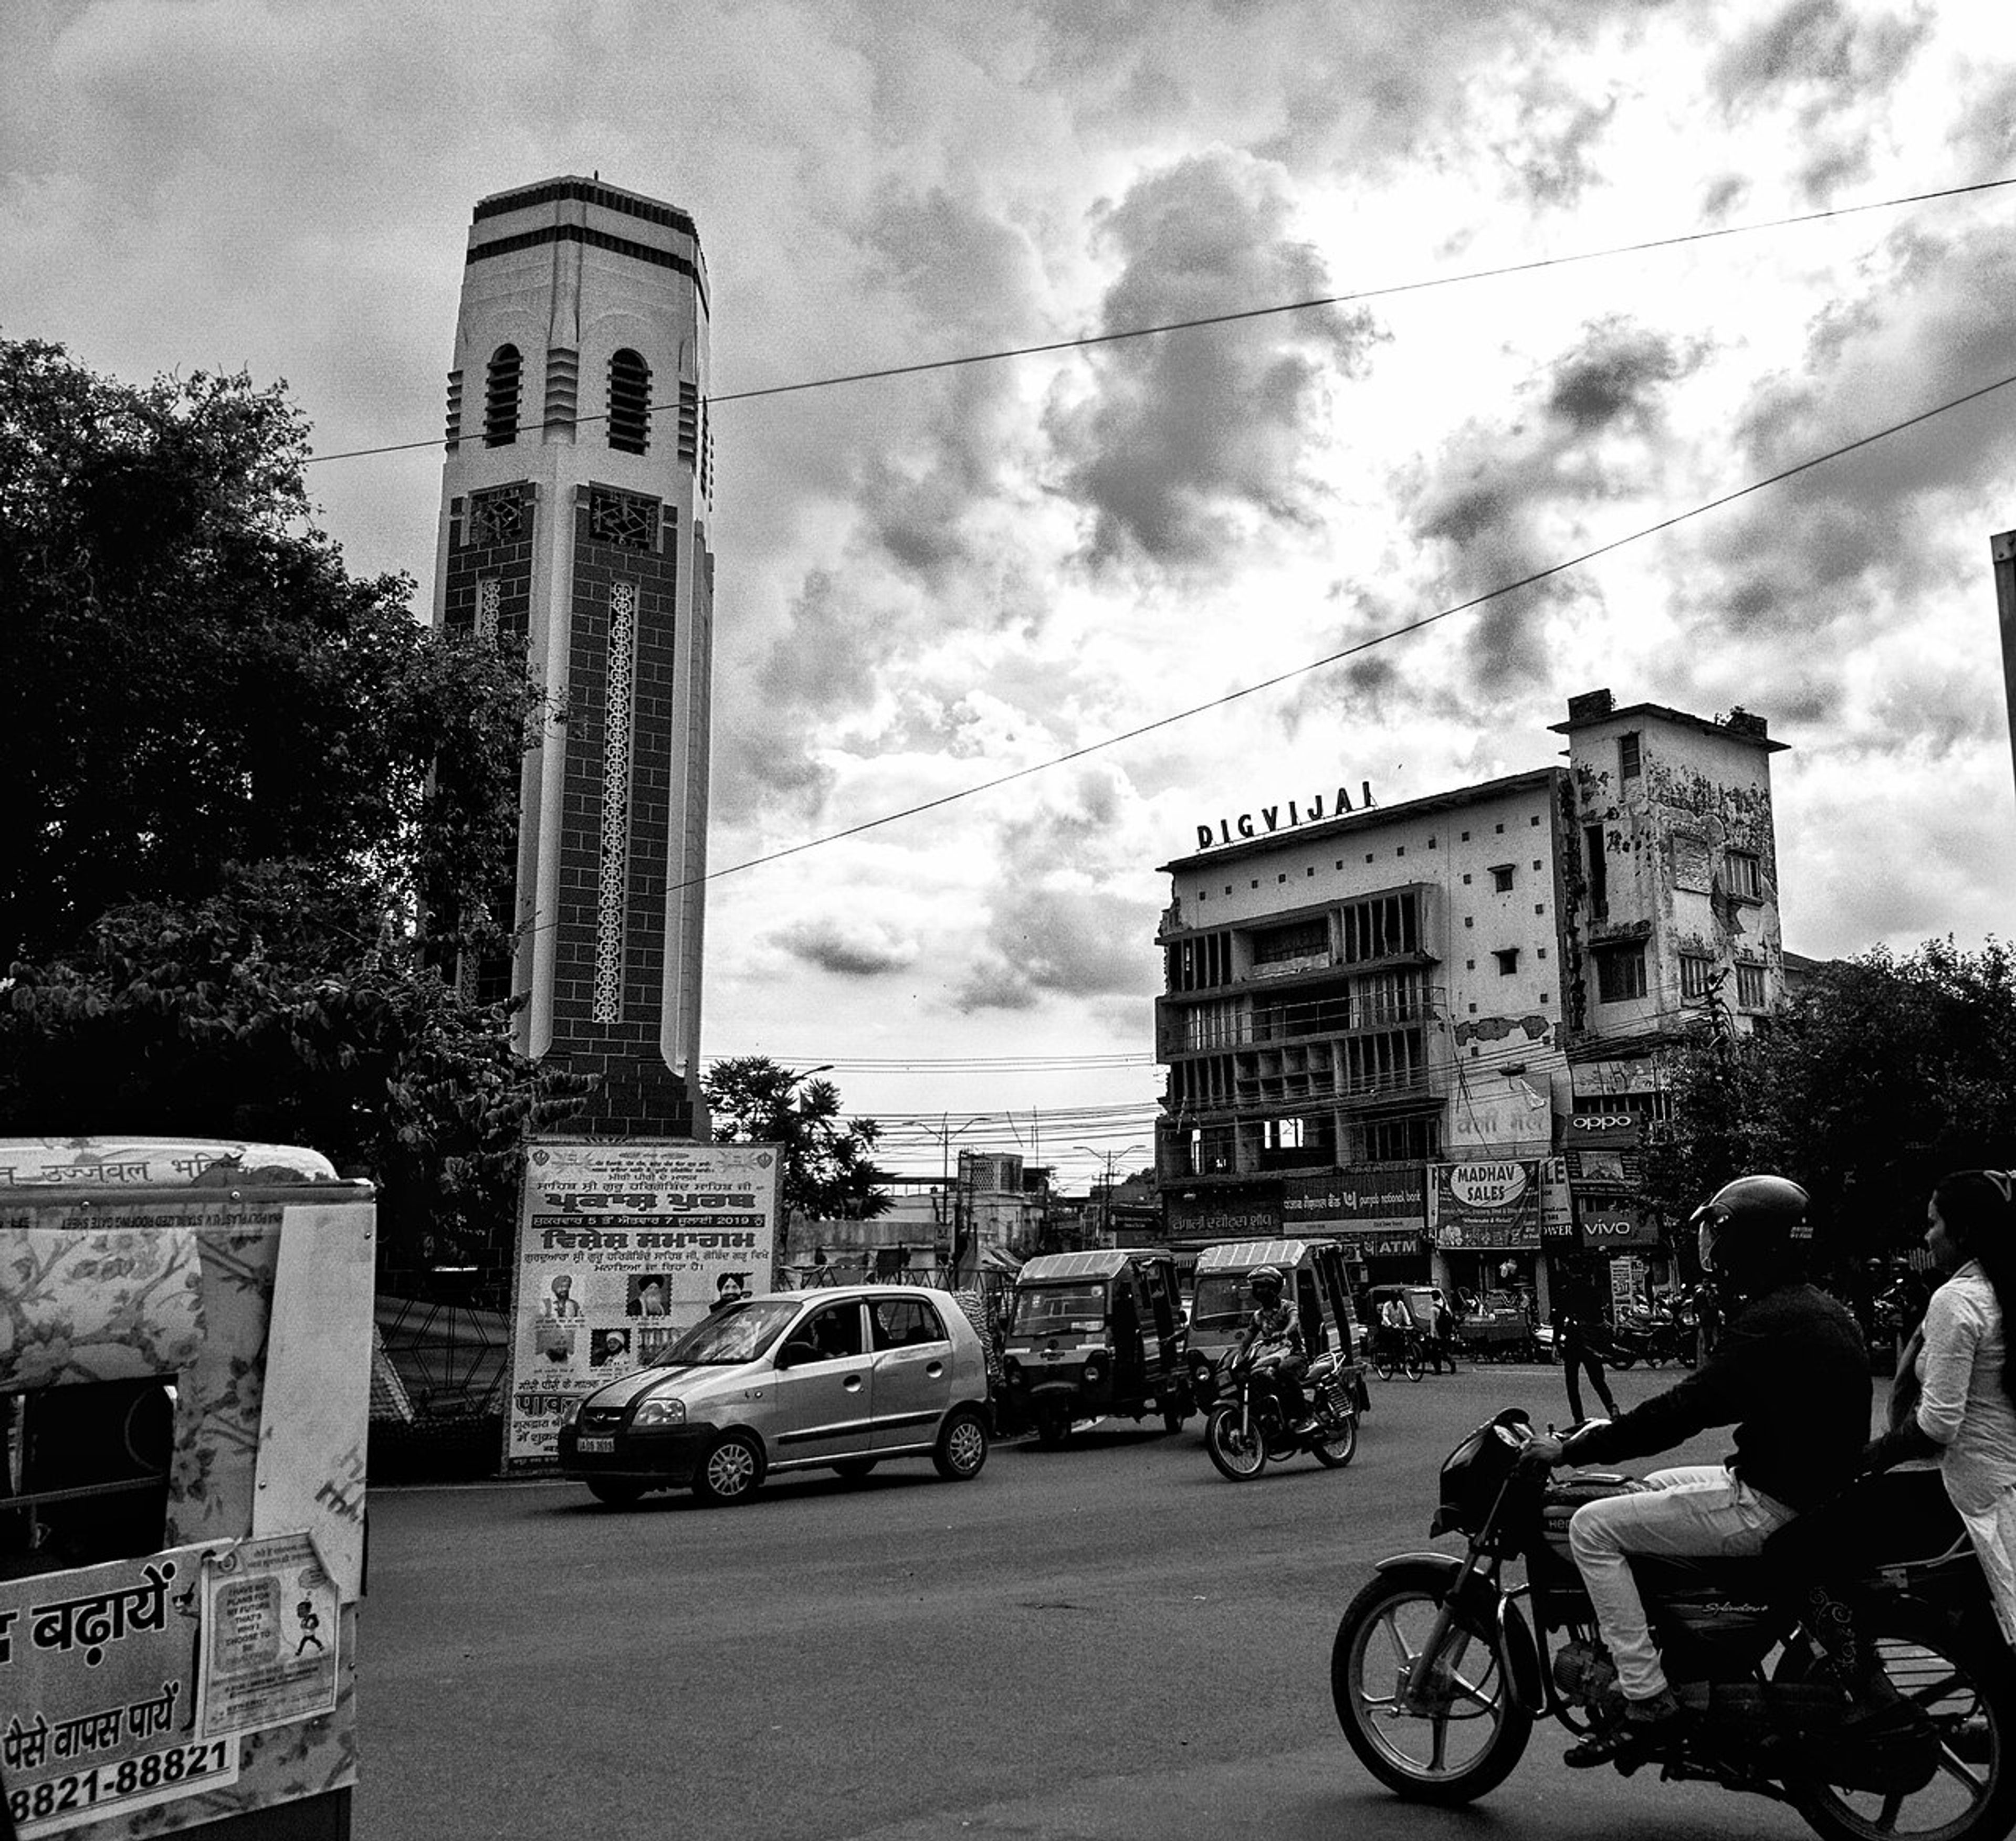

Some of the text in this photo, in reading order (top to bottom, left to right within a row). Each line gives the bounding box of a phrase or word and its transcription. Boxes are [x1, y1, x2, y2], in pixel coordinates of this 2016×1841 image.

[1197, 782, 1371, 849] DIGVIJAI
[1458, 1166, 1514, 1182] MADHAV
[1468, 1186, 1505, 1201] SALES
[717, 1216, 750, 1225] 2019
[1584, 1219, 1629, 1235] vivo
[636, 1233, 755, 1248] ਸਮਾਗਮ
[1380, 1241, 1416, 1253] ATM
[54, 1707, 123, 1758] वापस
